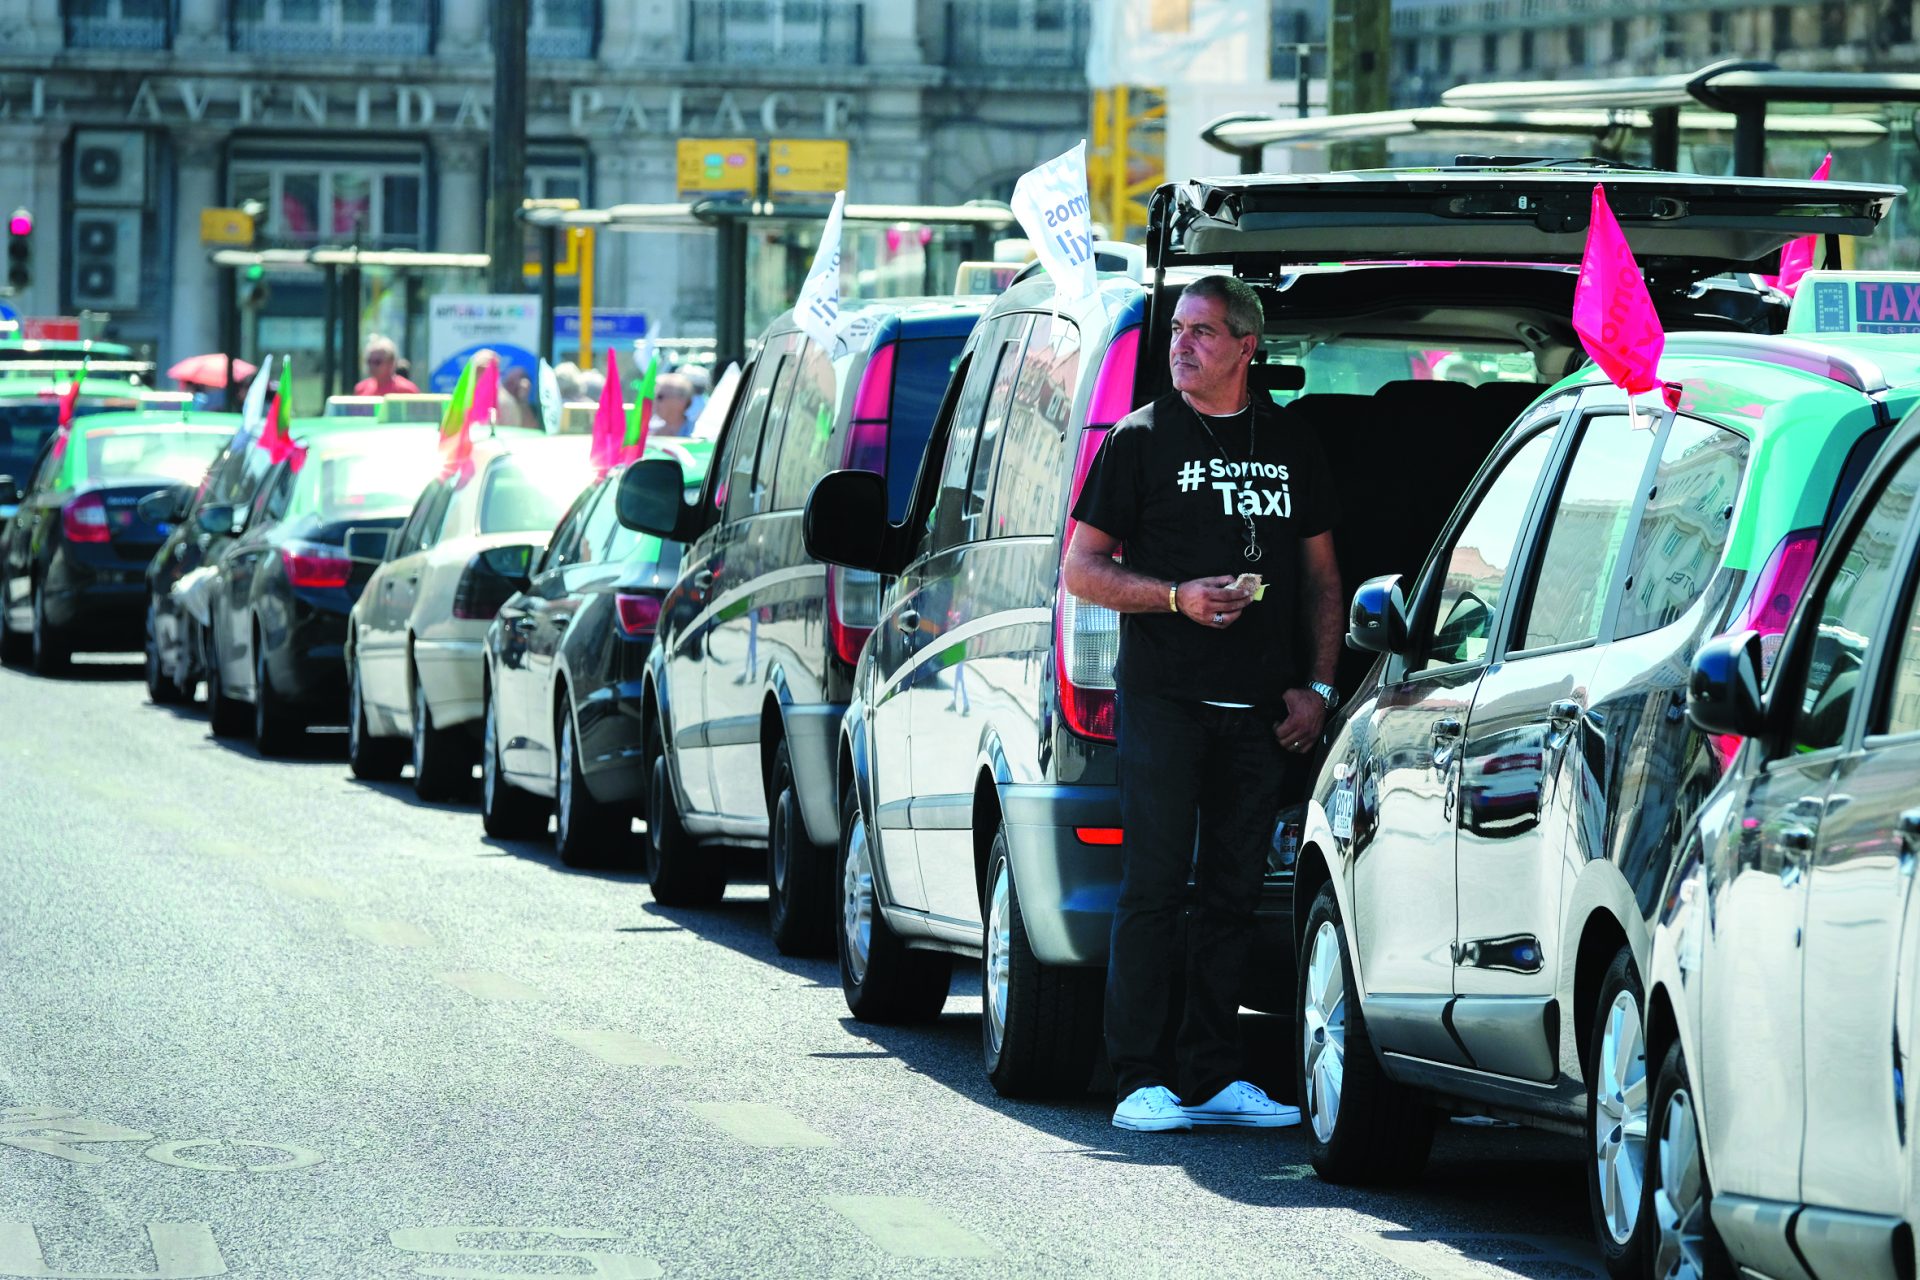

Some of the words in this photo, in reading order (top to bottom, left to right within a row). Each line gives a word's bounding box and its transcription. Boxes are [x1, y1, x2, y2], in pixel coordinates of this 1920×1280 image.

[126, 79, 489, 131] AVENIDA
[569, 87, 858, 134] PALACE
[1211, 480, 1291, 518] Táxi
[1335, 792, 1353, 818] 2012
